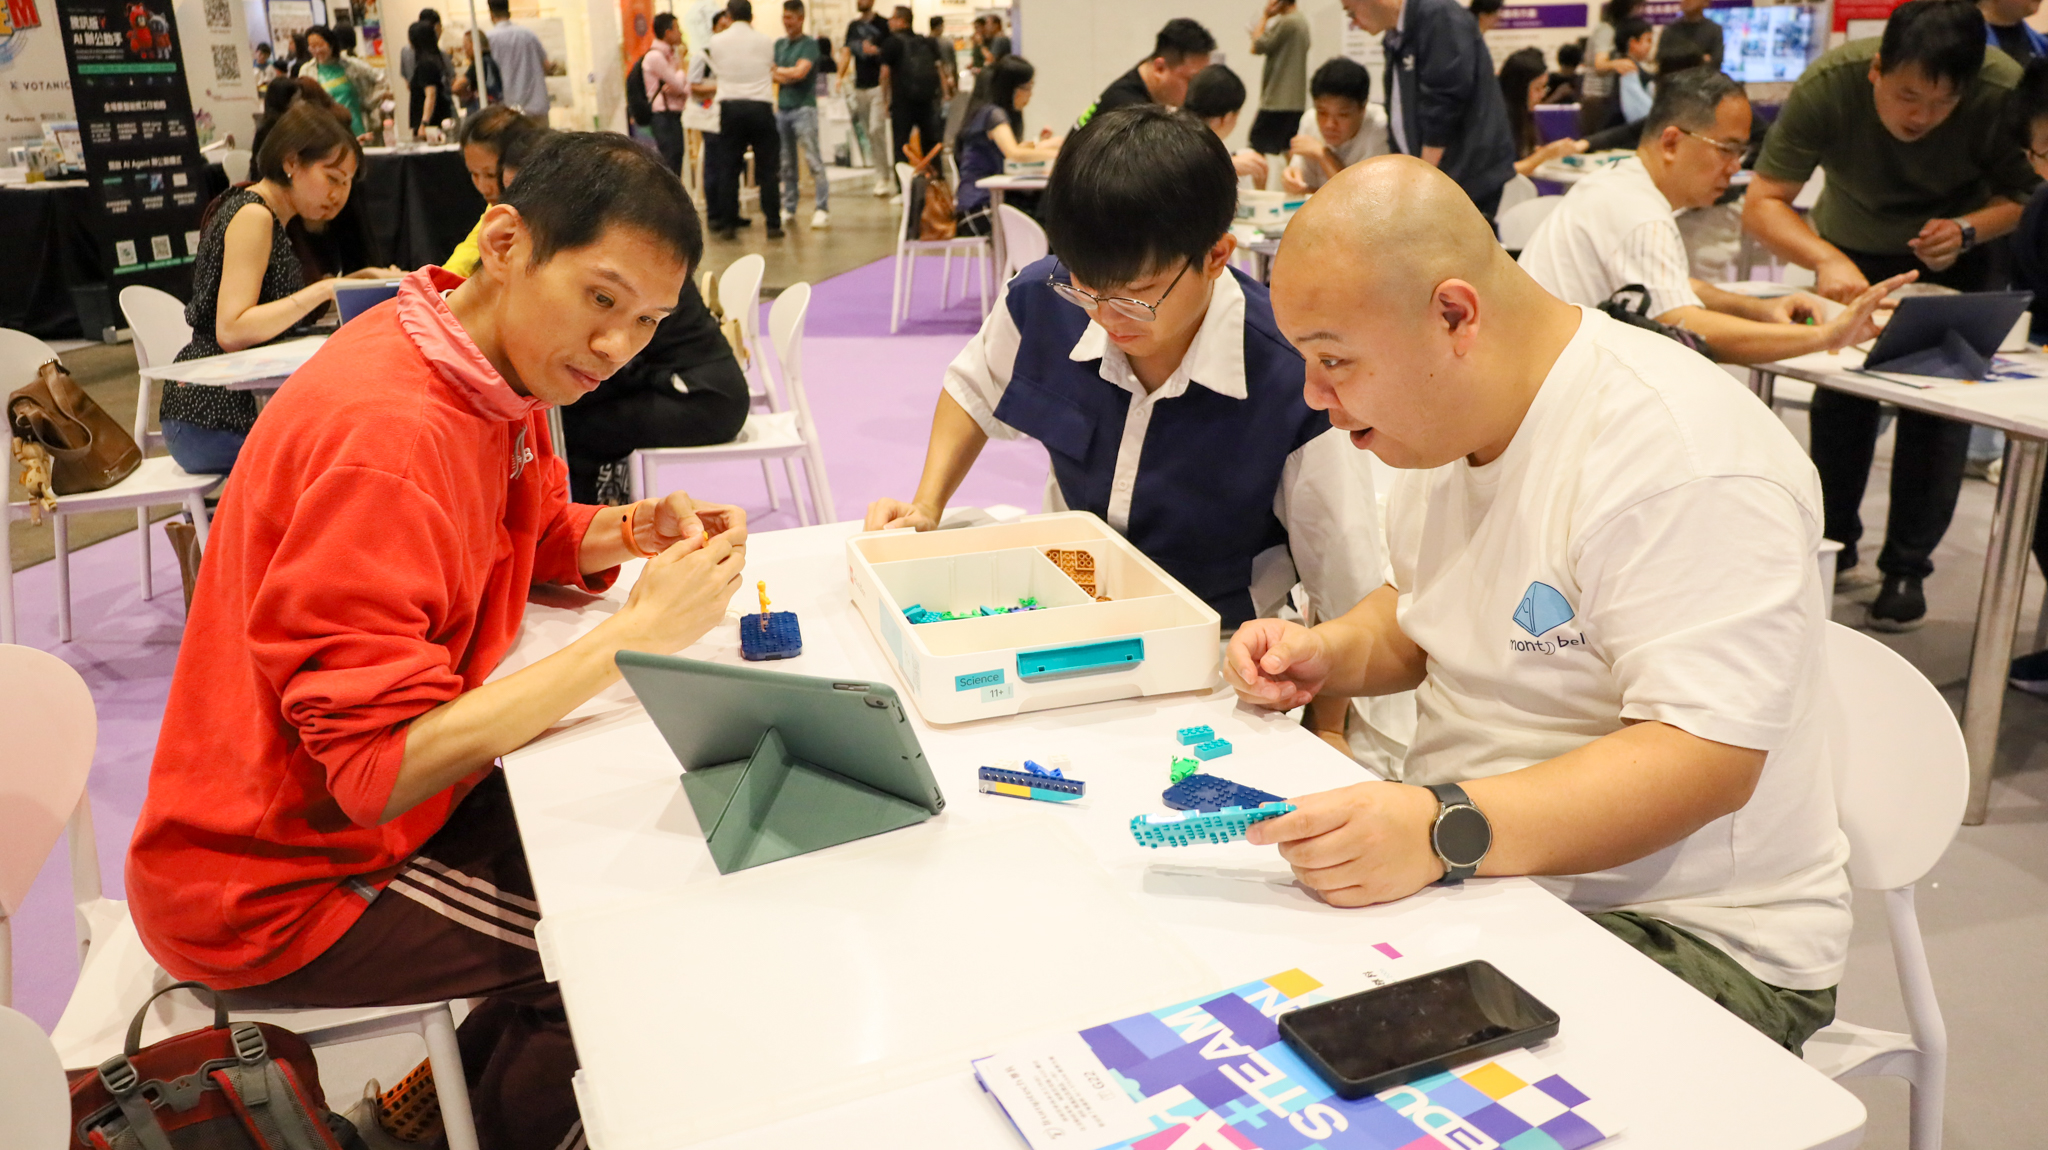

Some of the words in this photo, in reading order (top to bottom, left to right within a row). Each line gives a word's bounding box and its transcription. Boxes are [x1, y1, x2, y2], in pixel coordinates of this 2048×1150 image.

[23, 81, 71, 91] VOTANIC
[960, 674, 999, 687] Science
[990, 689, 1004, 698] 11+
[1161, 1005, 1349, 1140] STEAM
[1083, 1070, 1105, 1089] G22
